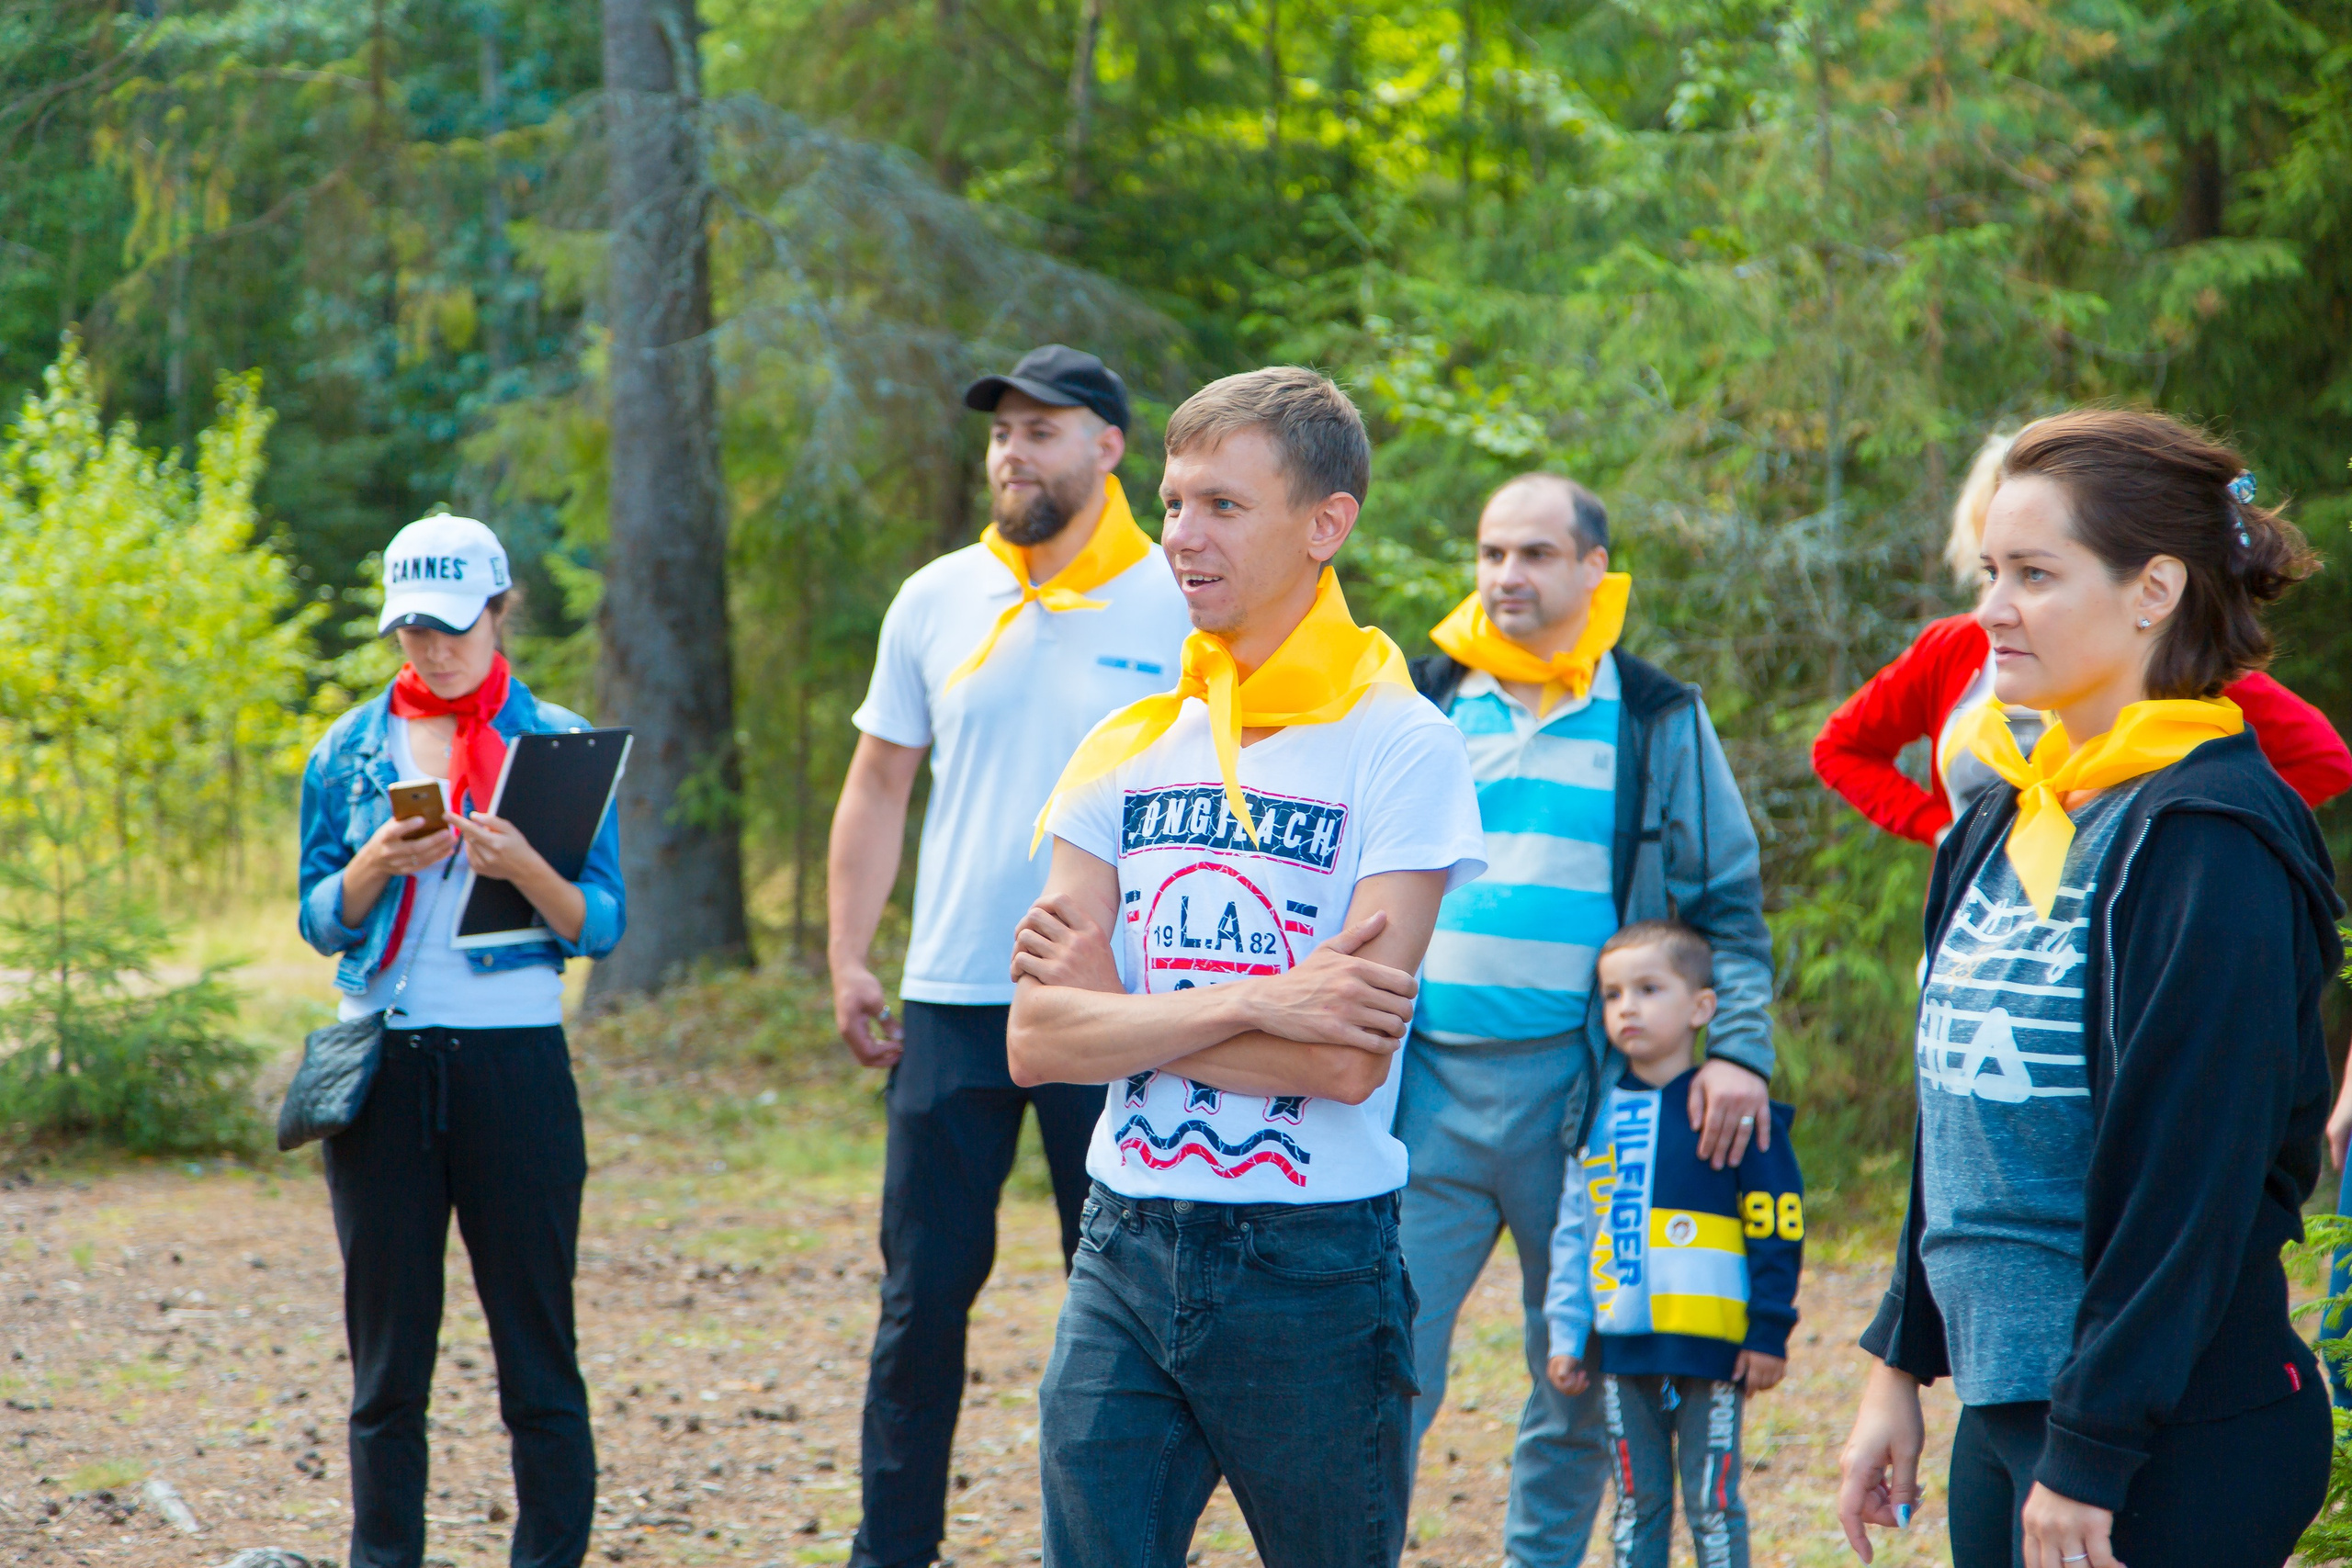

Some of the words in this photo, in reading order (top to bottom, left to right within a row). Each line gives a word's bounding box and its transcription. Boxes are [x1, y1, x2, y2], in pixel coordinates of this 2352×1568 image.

[392, 556, 467, 583] CANNES
[1154, 925, 1173, 947] 19
[1250, 932, 1277, 954] 82
[1611, 1099, 1652, 1288] HILFIGER
[1744, 1190, 1805, 1242] 98
